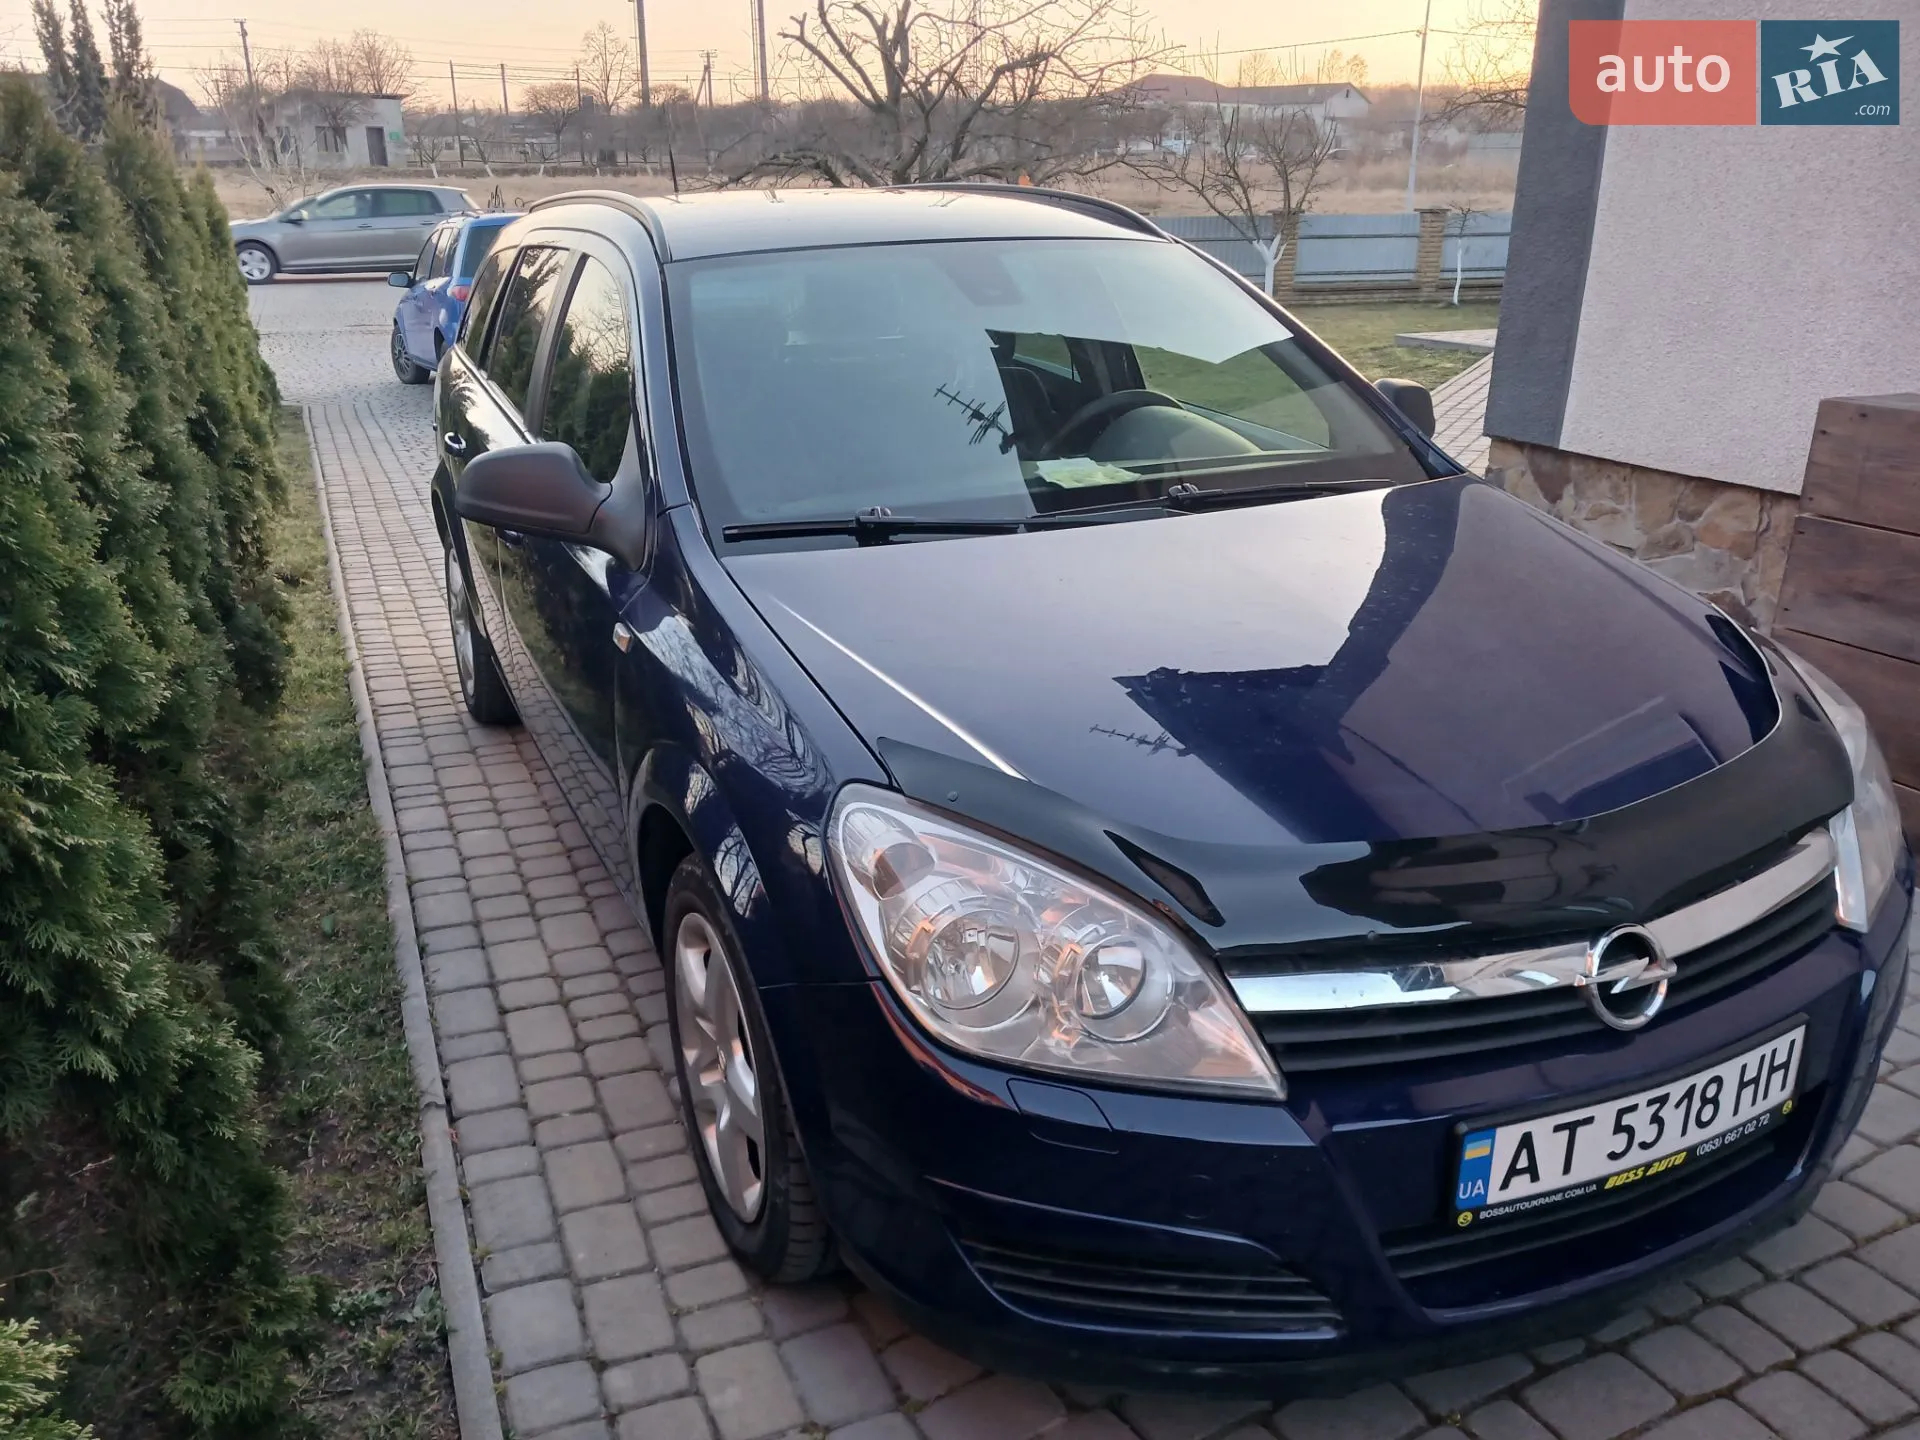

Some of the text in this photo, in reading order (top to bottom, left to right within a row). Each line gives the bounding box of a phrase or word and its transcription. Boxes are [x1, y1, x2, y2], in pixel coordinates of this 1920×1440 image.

[1498, 1038, 1796, 1191] AT 5318 HH
[1696, 1137, 1723, 1157] (063)
[1724, 1127, 1743, 1145] 667
[1758, 1113, 1771, 1127] 72
[1458, 1179, 1485, 1199] UA
[1604, 1152, 1688, 1189] BOSS AUTO
[1479, 1184, 1597, 1219] BOSSAUTOUKRAINE.COM.UA
